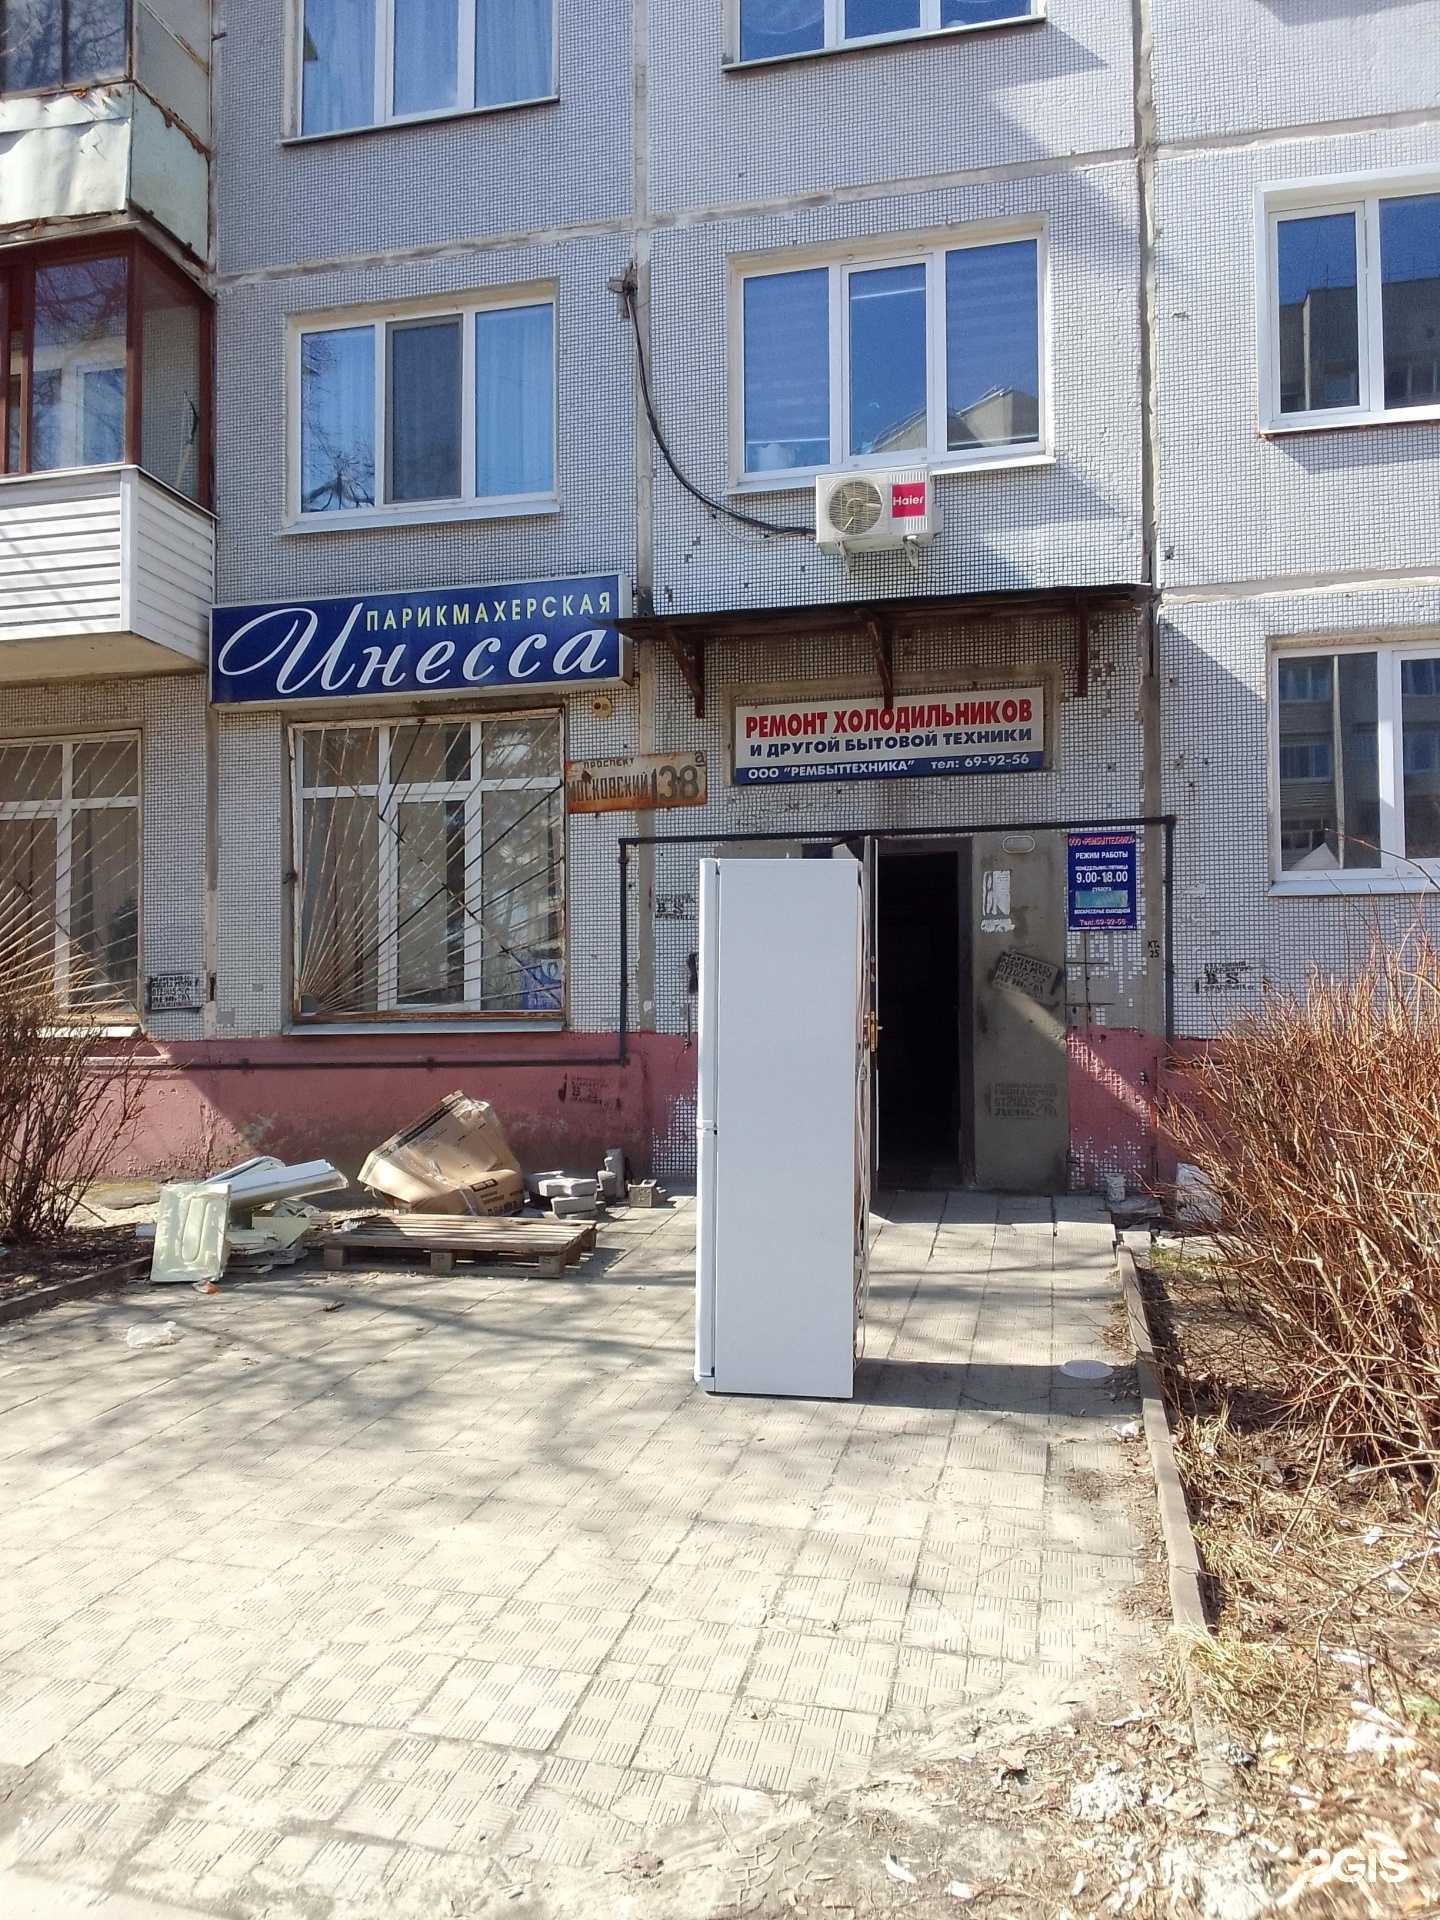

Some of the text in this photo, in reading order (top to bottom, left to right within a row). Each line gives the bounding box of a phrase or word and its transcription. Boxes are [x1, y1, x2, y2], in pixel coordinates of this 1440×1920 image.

[892, 495, 925, 506] Haier
[366, 592, 610, 632] ПАРИКМАХЕРСКАЯ
[218, 602, 608, 694] Инесса
[745, 699, 1033, 738] РЕМОНТ ХОЛОДИЛЬНИКОВ
[750, 728, 1032, 758] И ДРУГОЙ БЫТОВОЙ ТЕХНИКИ
[583, 757, 635, 769] ПРОСПЕКТ
[748, 769, 779, 779] ООО
[930, 759, 960, 769] тел:
[964, 753, 1030, 768] 69-92-56
[651, 765, 699, 801] 138
[1075, 850, 1129, 860] РЕЖИМ РАБОТЫ
[1076, 871, 1129, 883] 9.00-18.00
